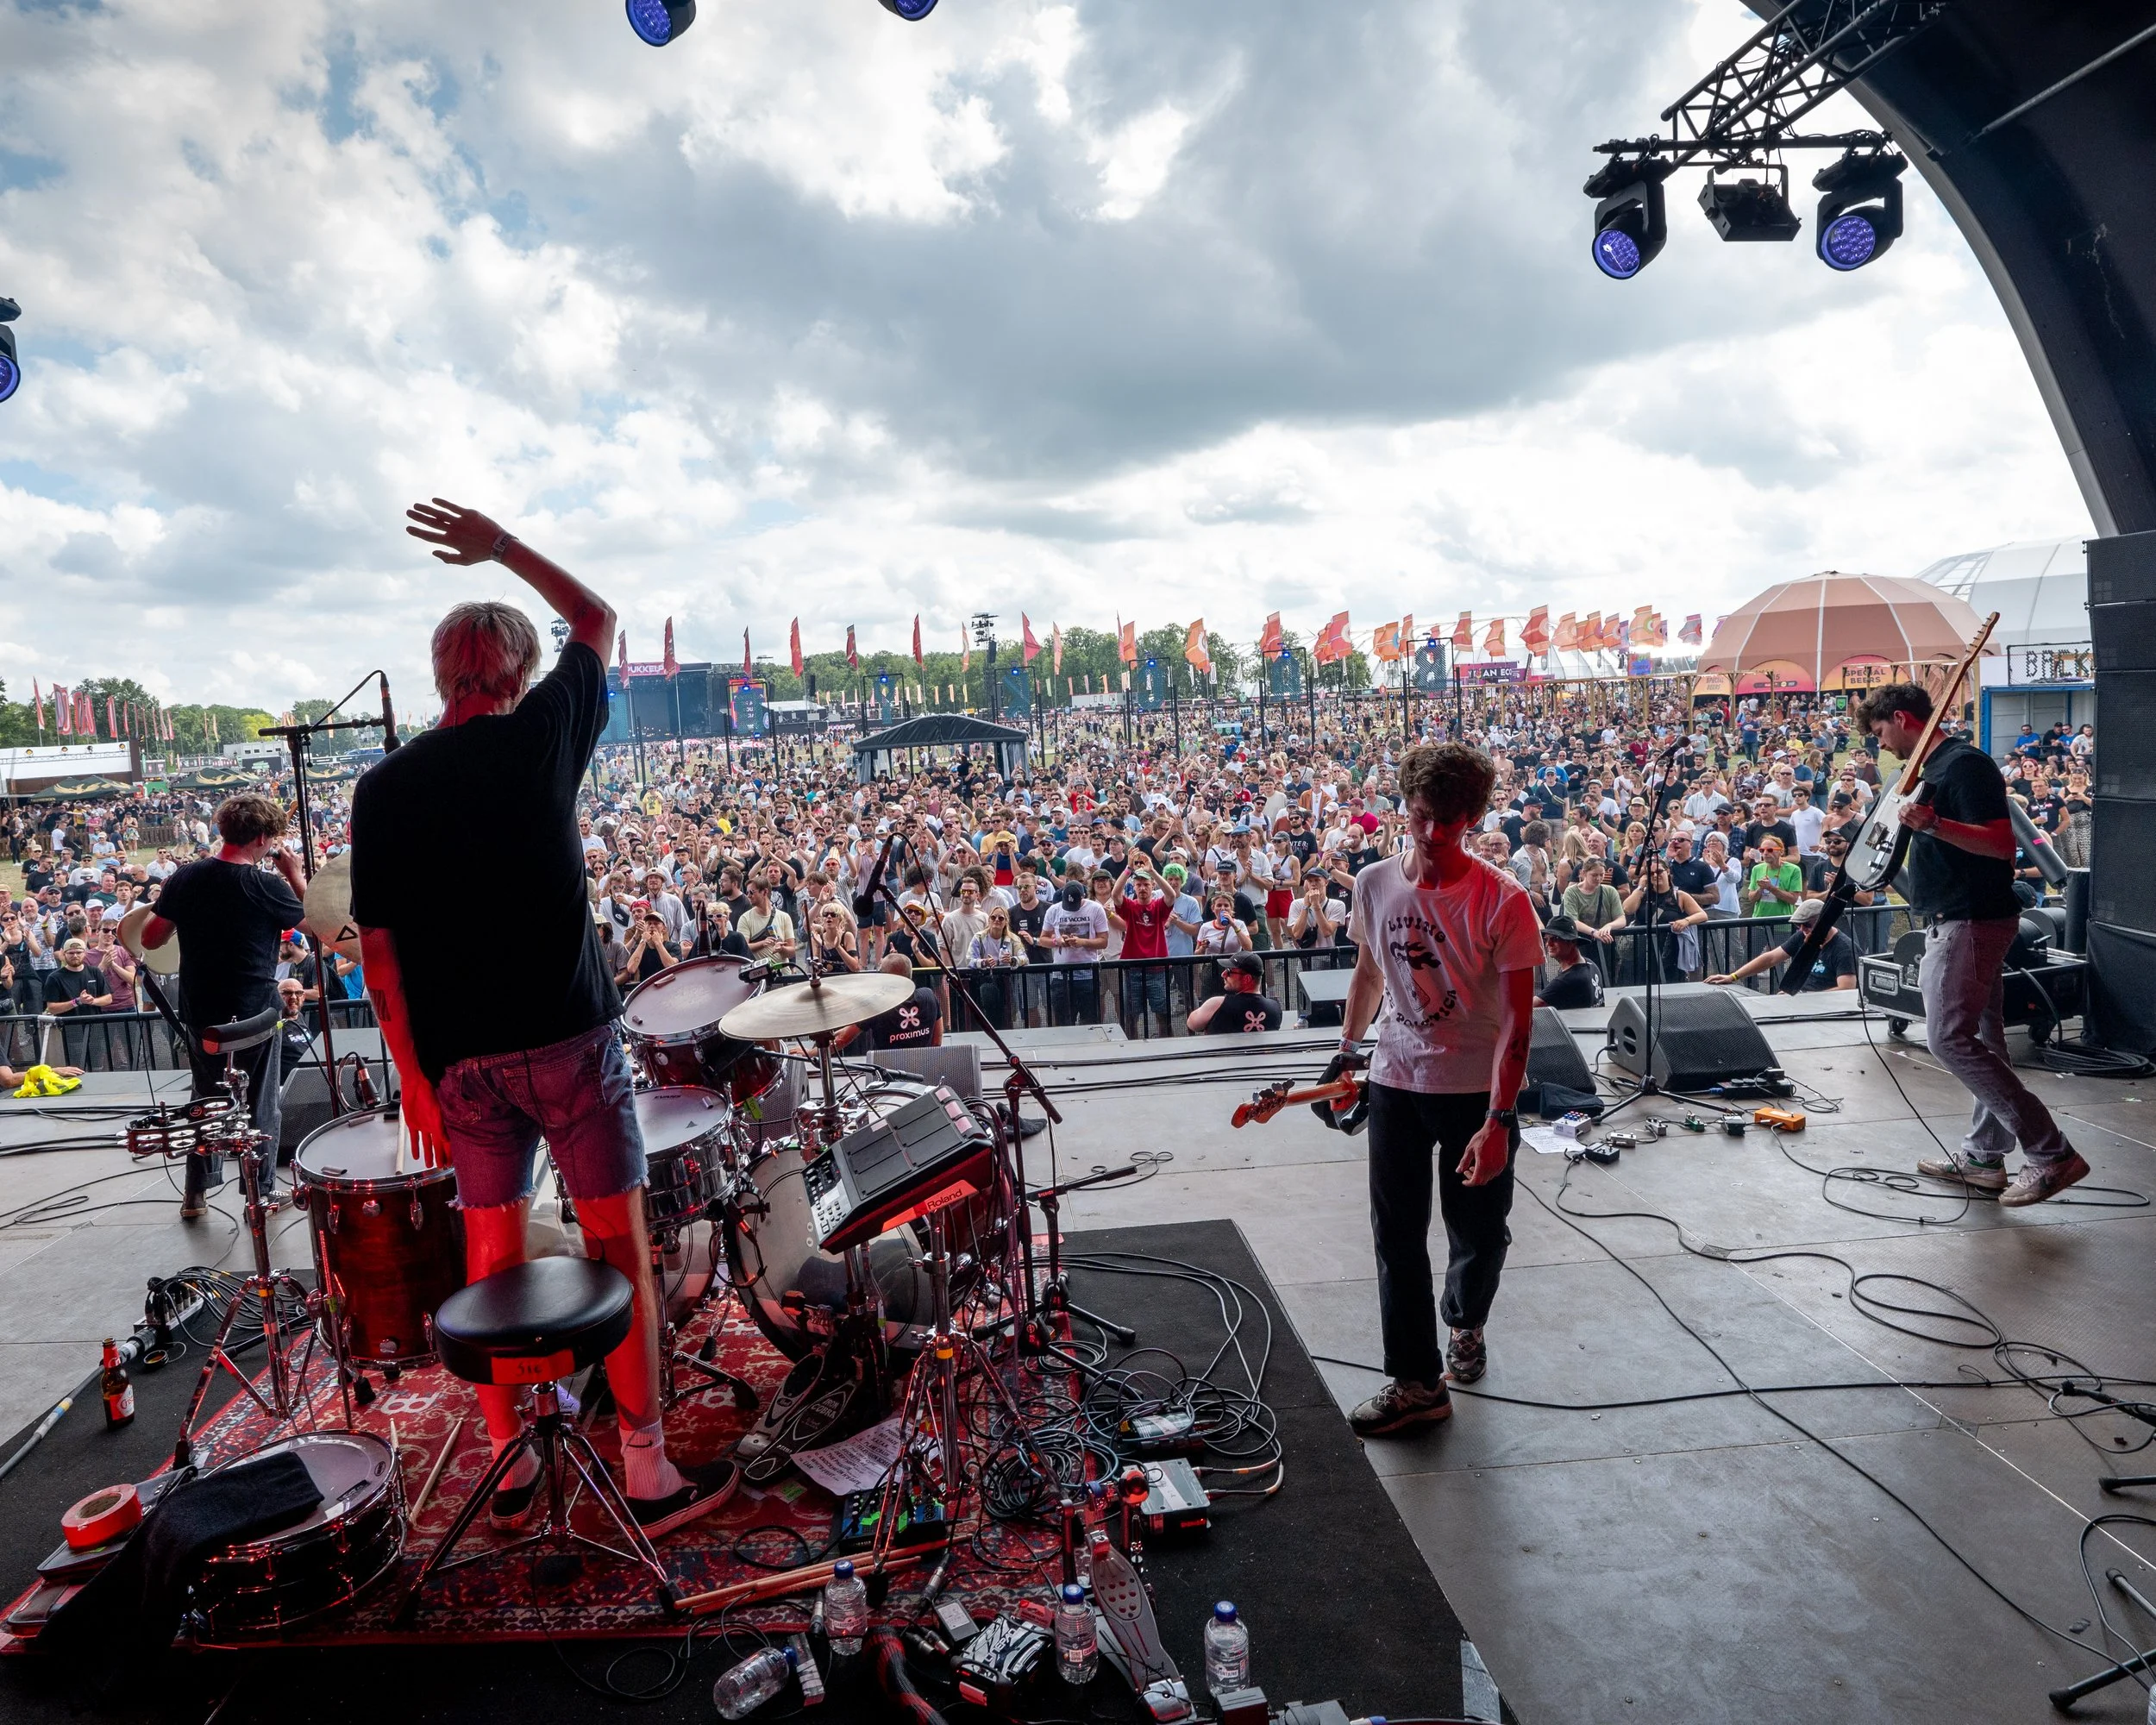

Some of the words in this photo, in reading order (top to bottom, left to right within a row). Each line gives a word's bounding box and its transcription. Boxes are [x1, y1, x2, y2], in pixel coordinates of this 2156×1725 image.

[1388, 916, 1446, 943] LIVING
[889, 1027, 931, 1044] proximus
[927, 1189, 962, 1210] Roland
[811, 1403, 837, 1420] COBRA
